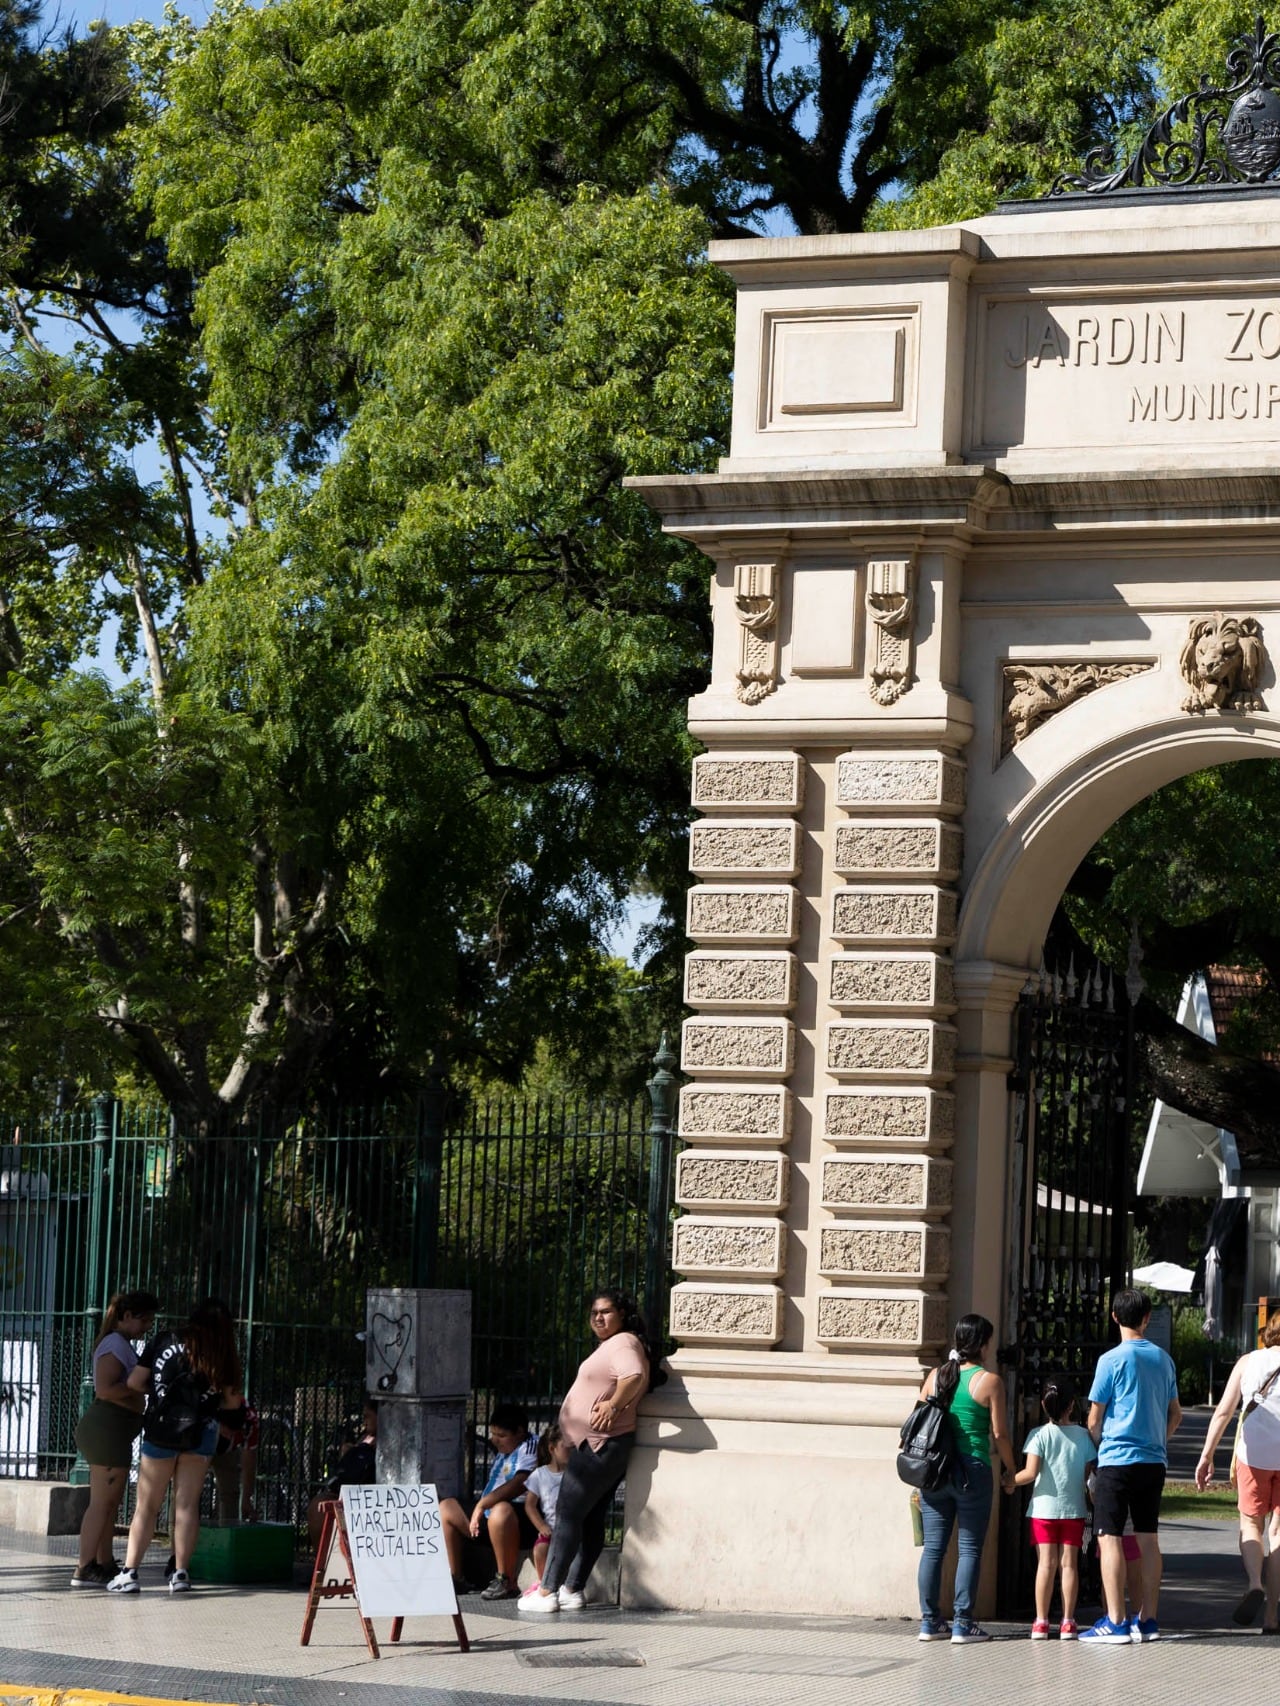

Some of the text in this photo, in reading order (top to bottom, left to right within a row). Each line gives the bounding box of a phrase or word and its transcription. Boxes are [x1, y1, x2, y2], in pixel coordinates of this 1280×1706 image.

[1003, 311, 1185, 369] JARDIN
[349, 1486, 435, 1510] HELADOS
[351, 1510, 441, 1533] MARCIANOS
[356, 1535, 439, 1558] FRUTALES
